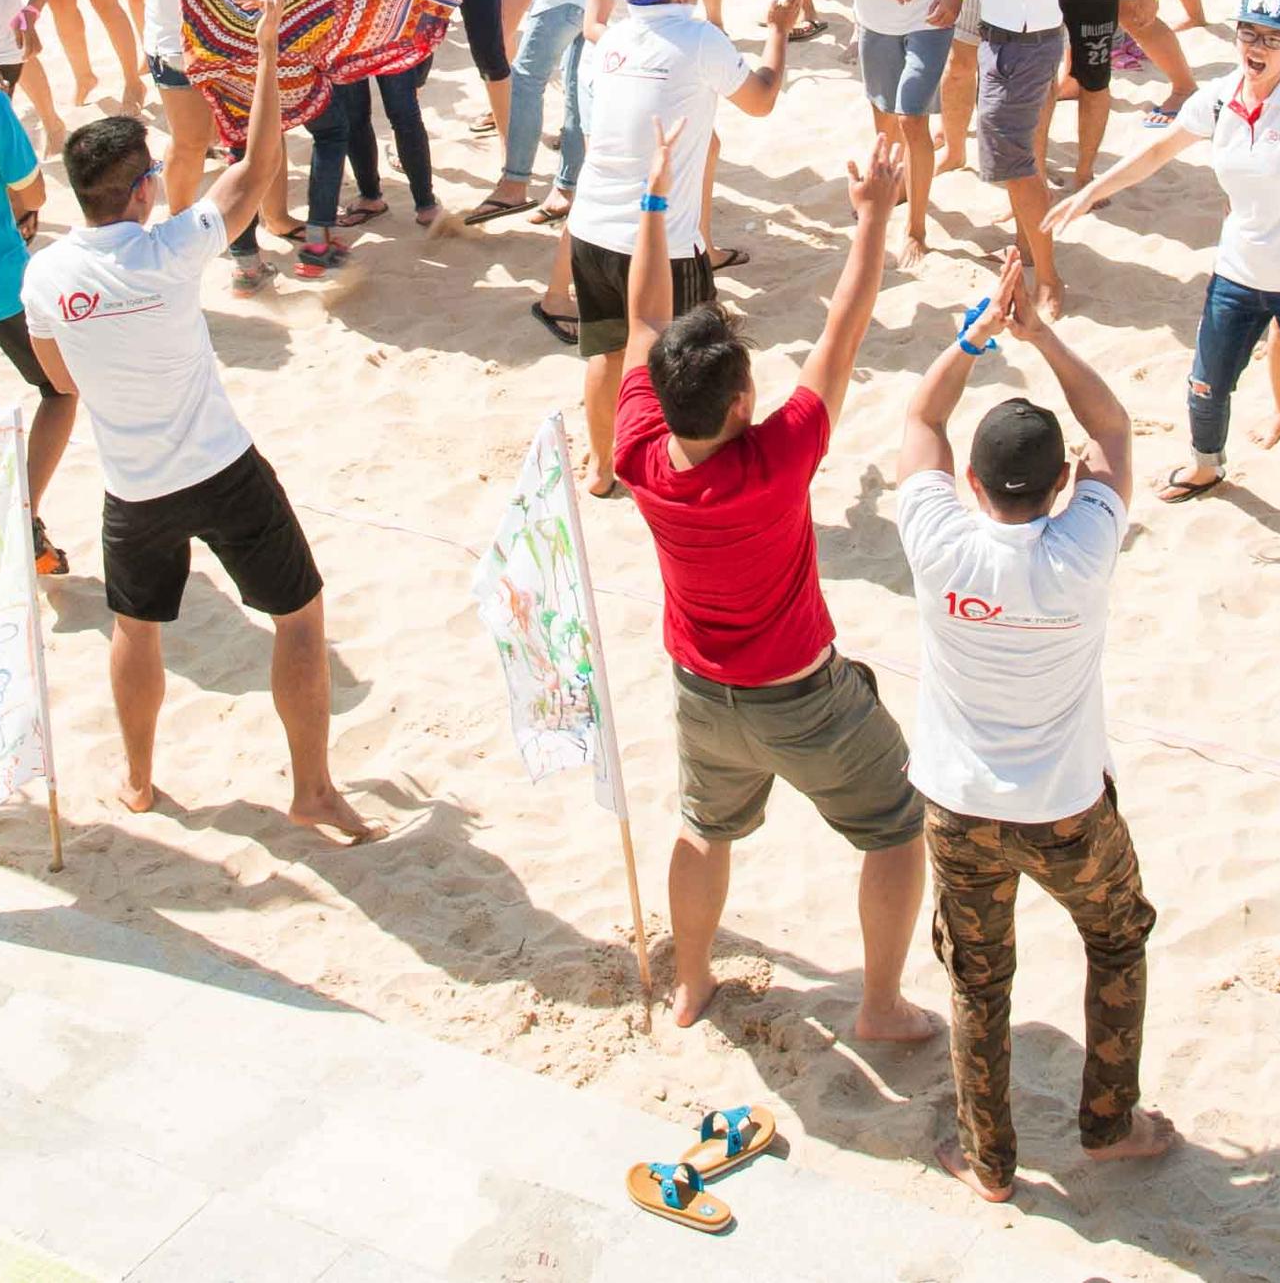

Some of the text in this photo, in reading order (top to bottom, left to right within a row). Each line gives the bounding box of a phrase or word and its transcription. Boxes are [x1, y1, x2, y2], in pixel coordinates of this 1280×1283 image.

[1088, 48, 1109, 65] 22
[58, 291, 100, 321] 10
[944, 591, 1003, 621] 10
